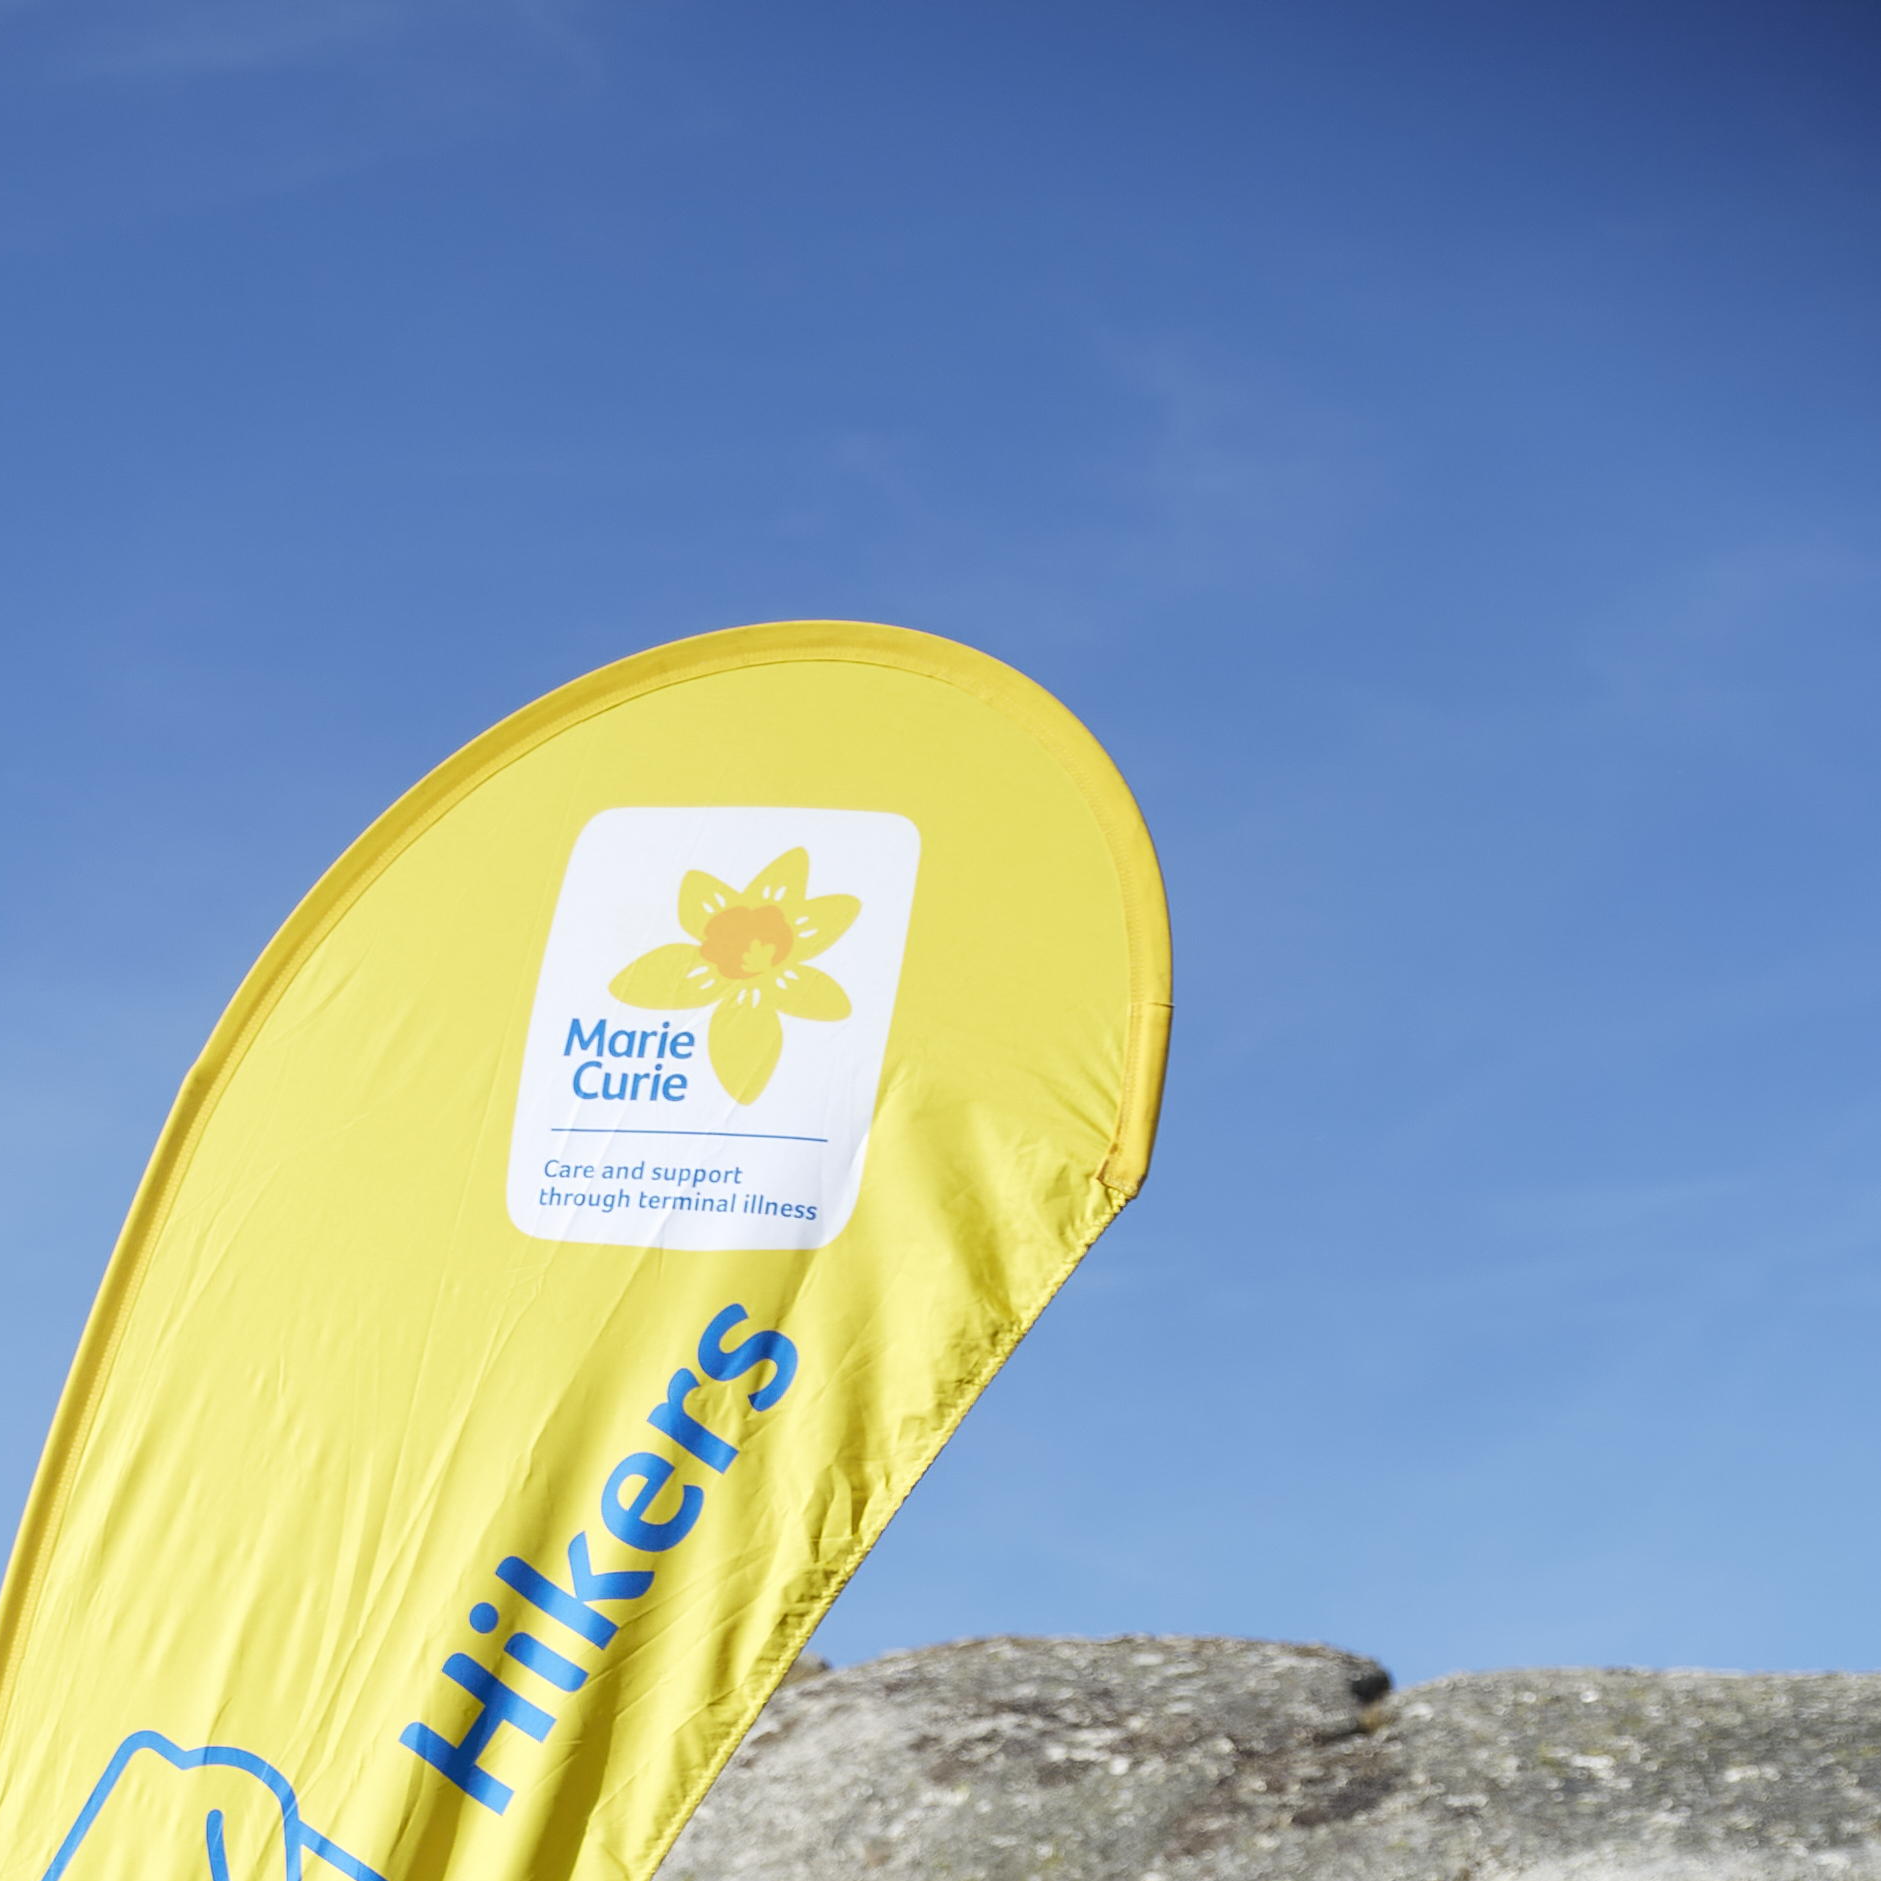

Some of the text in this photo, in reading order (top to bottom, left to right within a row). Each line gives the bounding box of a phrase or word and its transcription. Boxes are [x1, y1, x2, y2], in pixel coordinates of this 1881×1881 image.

[563, 1017, 696, 1060] Marie
[572, 1059, 689, 1102] Curie
[543, 1159, 743, 1188] Care and support
[538, 1187, 818, 1221] through terminal illness
[399, 1303, 799, 1815] Hikers
